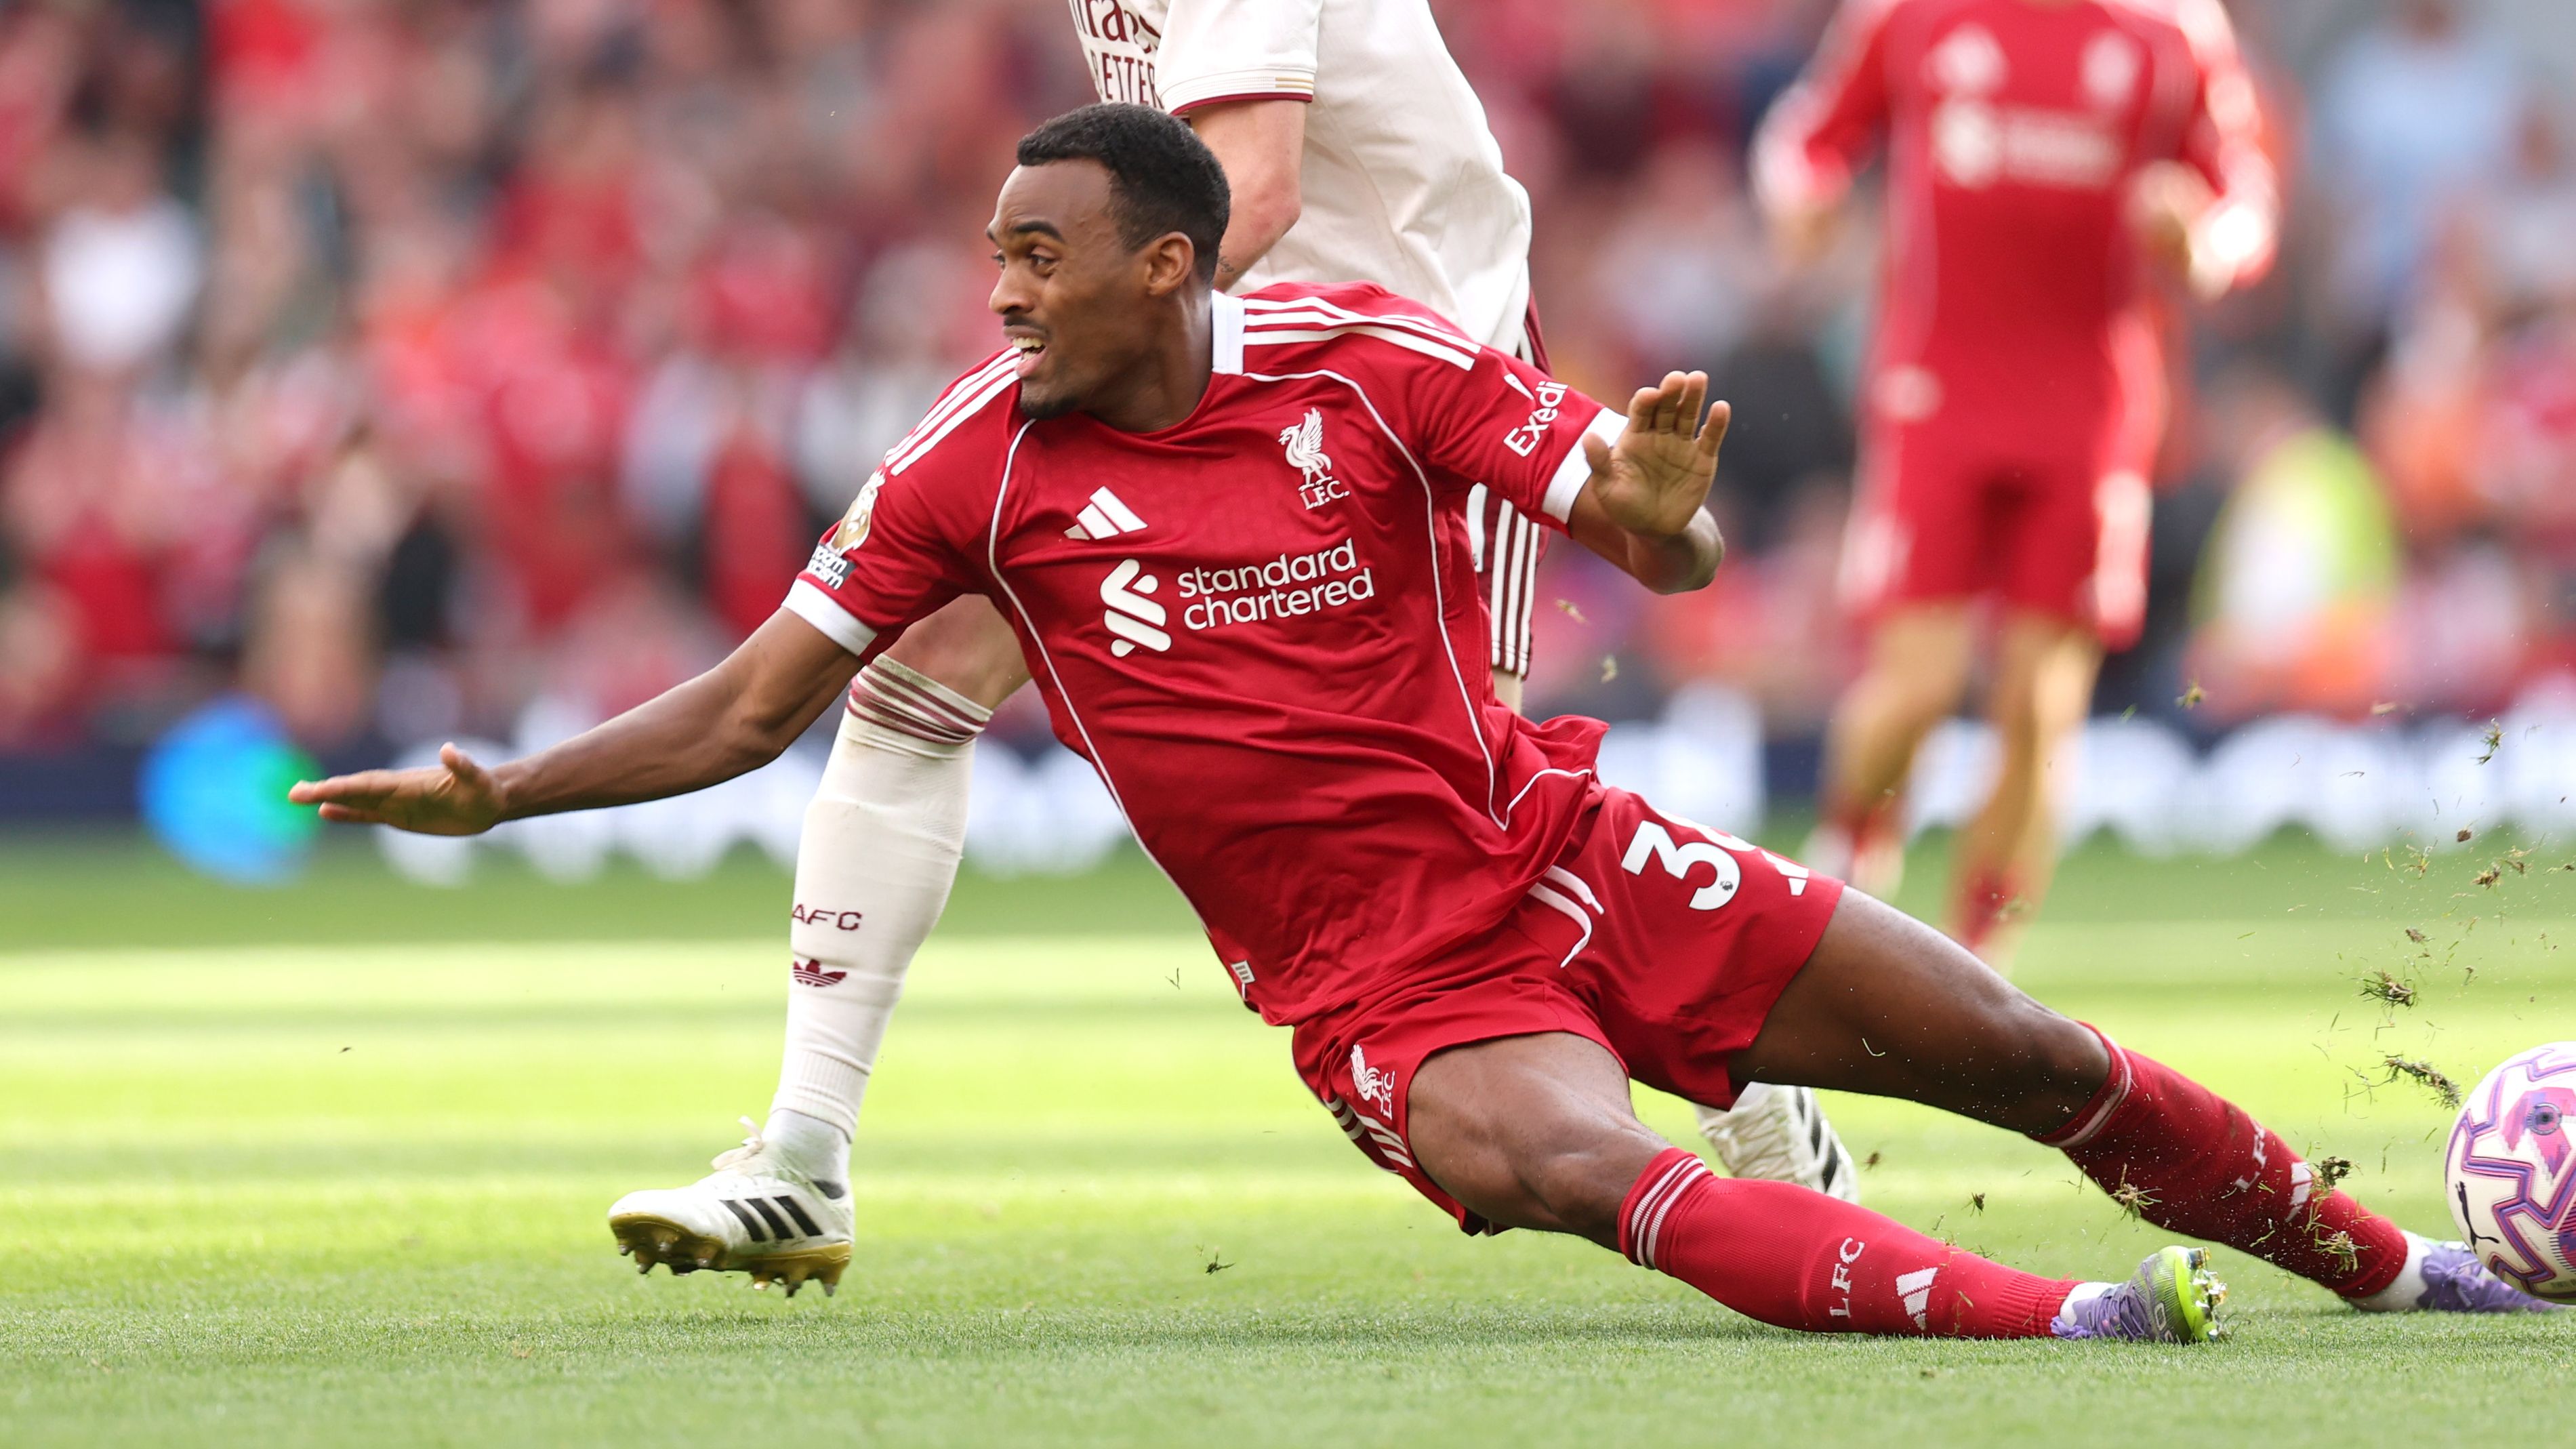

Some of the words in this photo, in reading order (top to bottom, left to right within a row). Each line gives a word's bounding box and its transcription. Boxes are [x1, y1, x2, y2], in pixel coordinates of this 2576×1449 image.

[1177, 537, 1357, 598] standard
[1183, 567, 1375, 631] chartered
[791, 903, 863, 931] AFC
[1829, 1236, 1865, 1319] LFC
